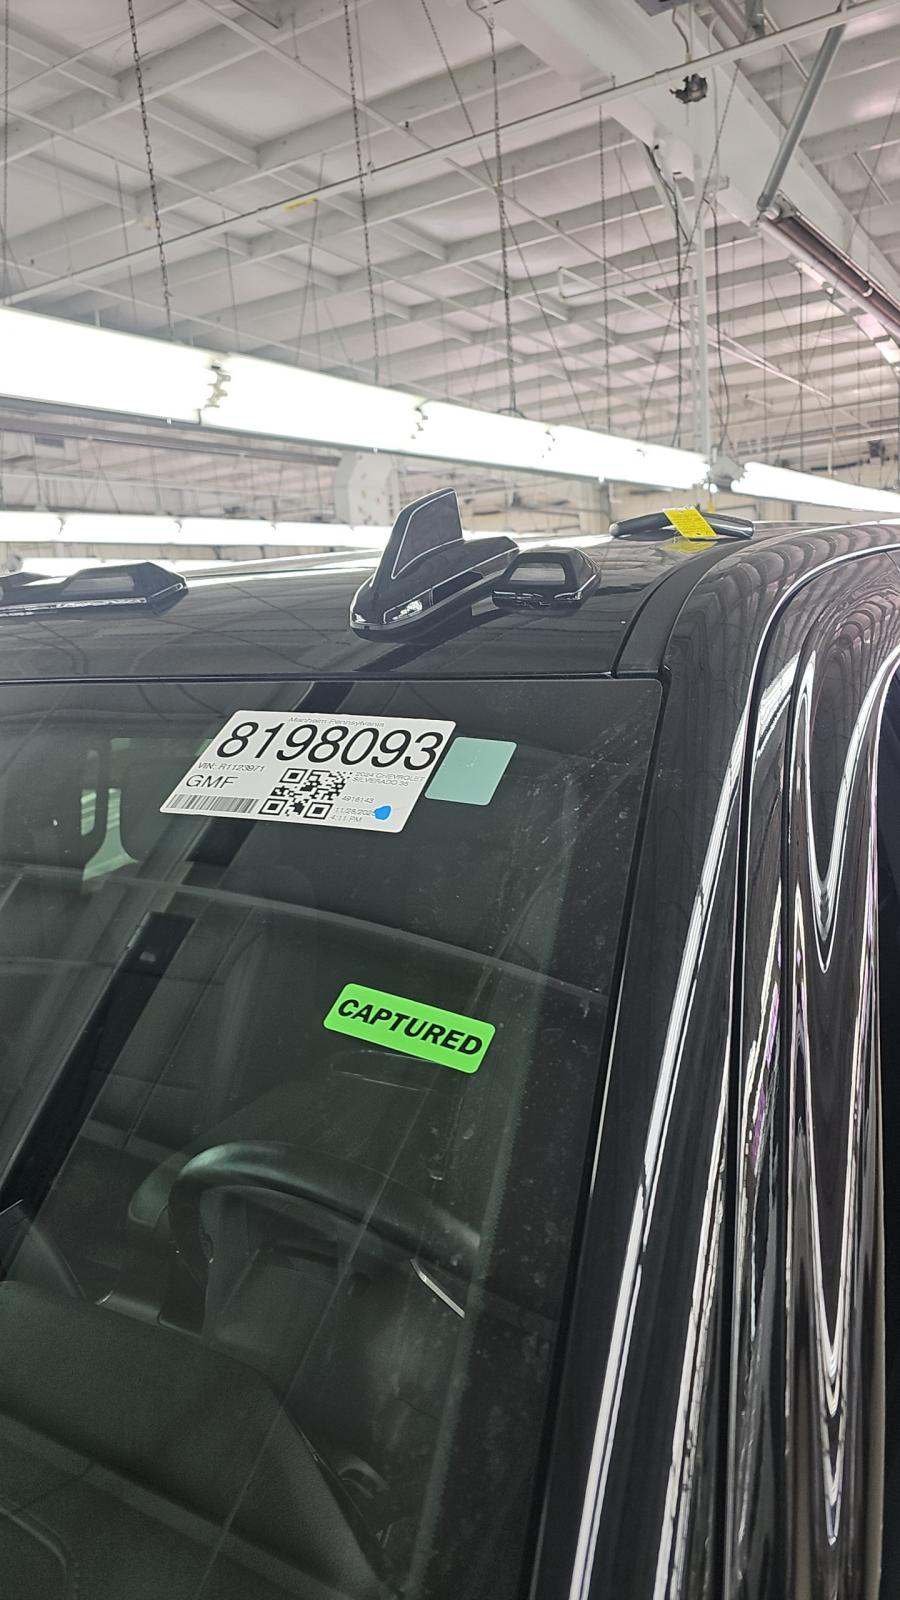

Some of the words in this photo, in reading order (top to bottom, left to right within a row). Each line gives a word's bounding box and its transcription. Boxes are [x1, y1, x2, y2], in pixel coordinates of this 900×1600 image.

[289, 716, 327, 724] Manheim
[328, 718, 385, 728] Pennsylvania
[216, 721, 444, 771] 8198093
[198, 762, 215, 770] VIN:
[186, 774, 239, 788] GMF
[352, 776, 398, 785] SILVERADO
[338, 998, 483, 1055] CAPTURED
